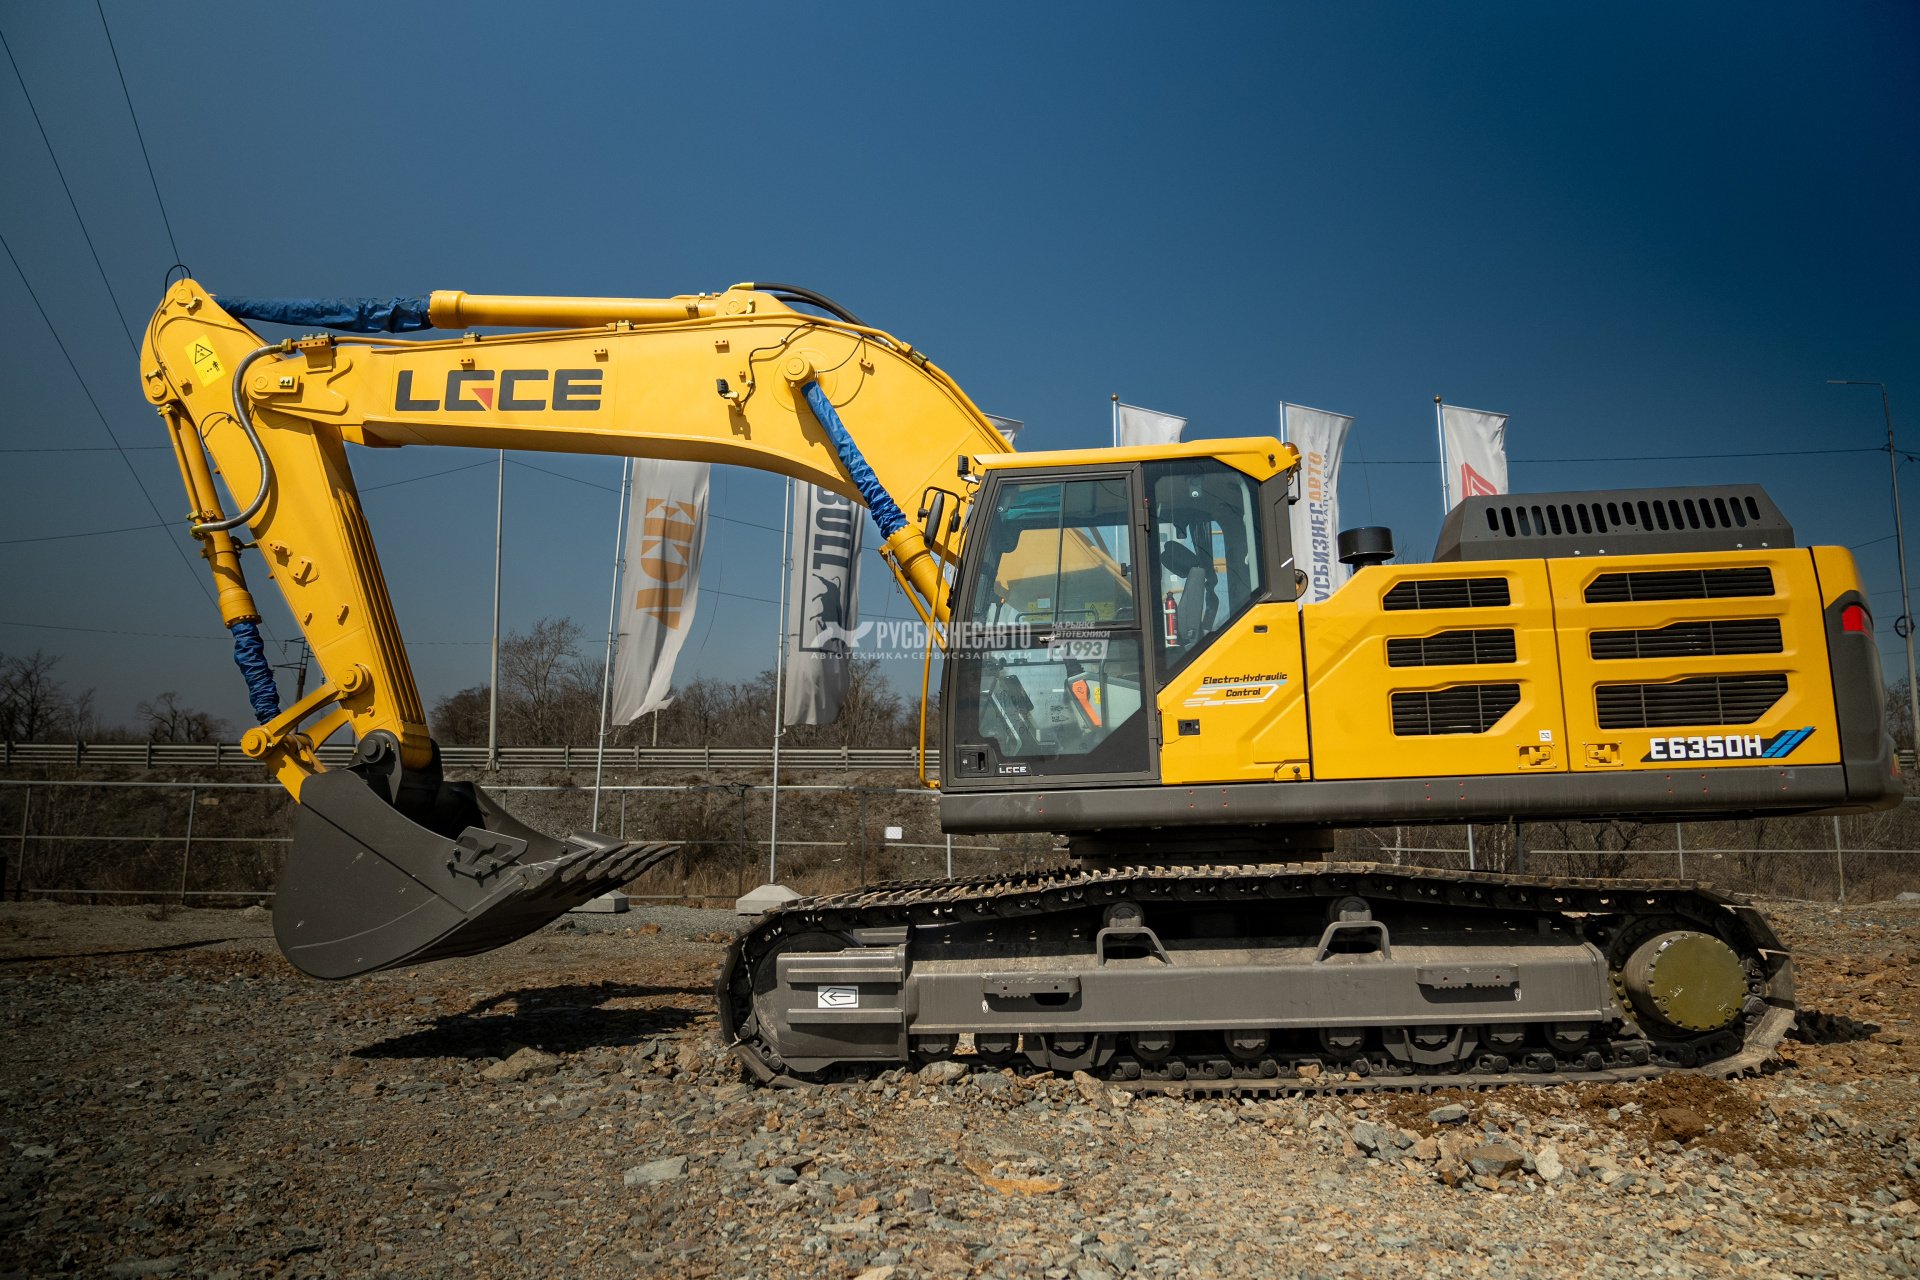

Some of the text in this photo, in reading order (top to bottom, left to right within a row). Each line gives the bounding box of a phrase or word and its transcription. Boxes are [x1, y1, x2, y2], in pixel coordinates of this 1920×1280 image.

[1308, 452, 1330, 602] УСБИЗНЕСАВТО
[1202, 672, 1287, 685] Electro-Hydraulic
[1226, 688, 1261, 697] Control
[1650, 734, 1762, 759] E6350H
